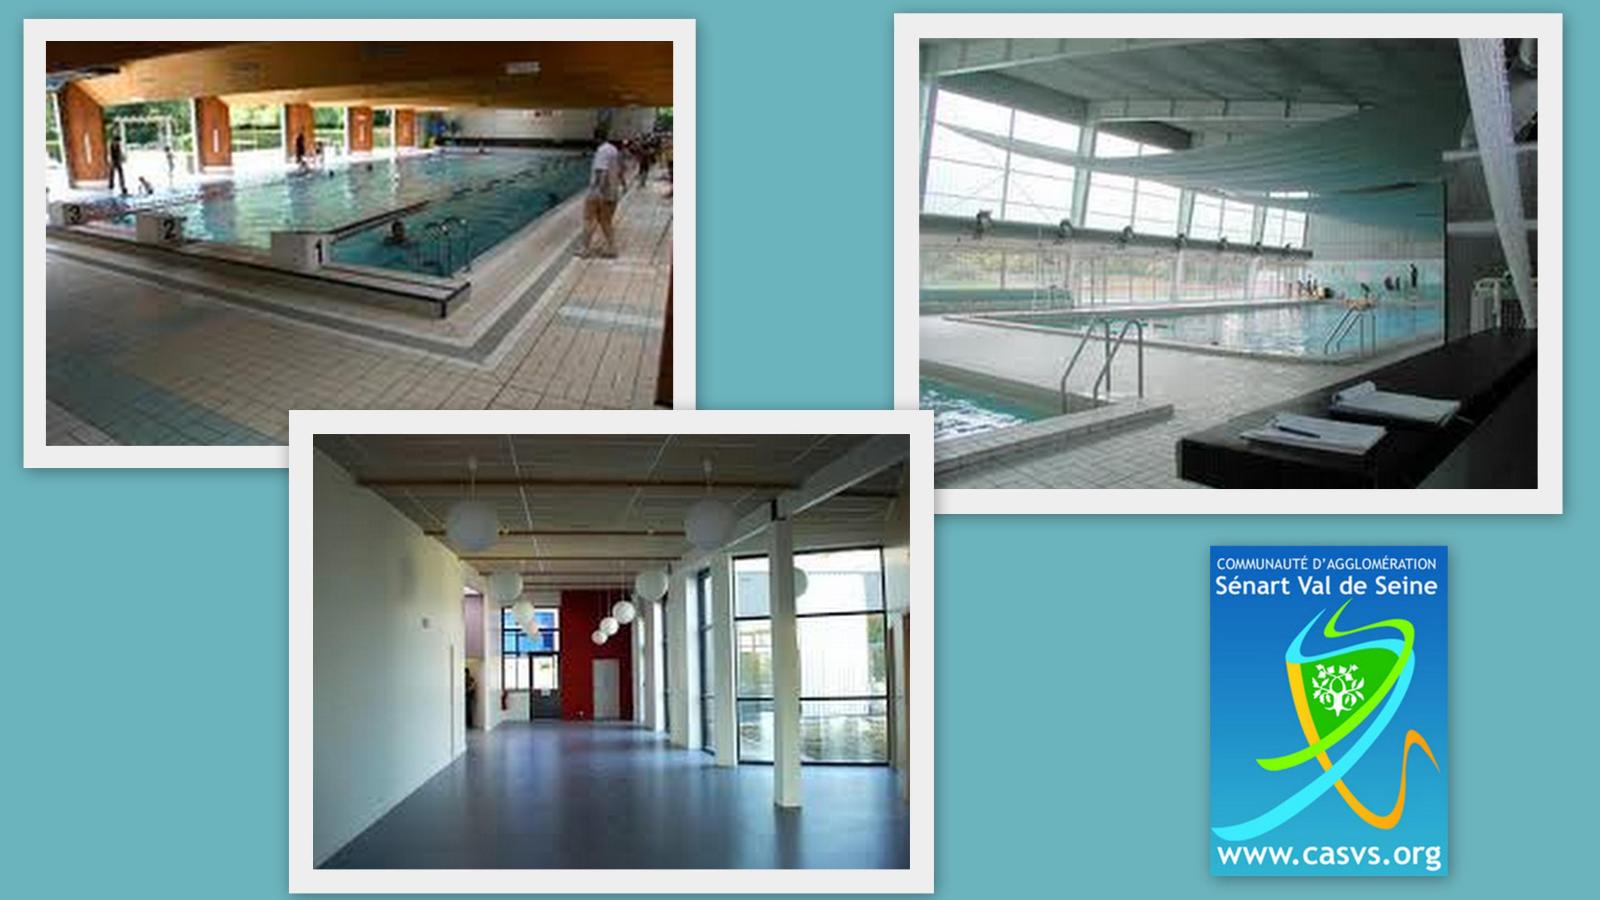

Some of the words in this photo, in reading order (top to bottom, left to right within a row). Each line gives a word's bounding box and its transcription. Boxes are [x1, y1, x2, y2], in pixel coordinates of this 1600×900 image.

[68, 204, 81, 224] 3
[163, 219, 176, 239] 2
[315, 238, 323, 263] 1
